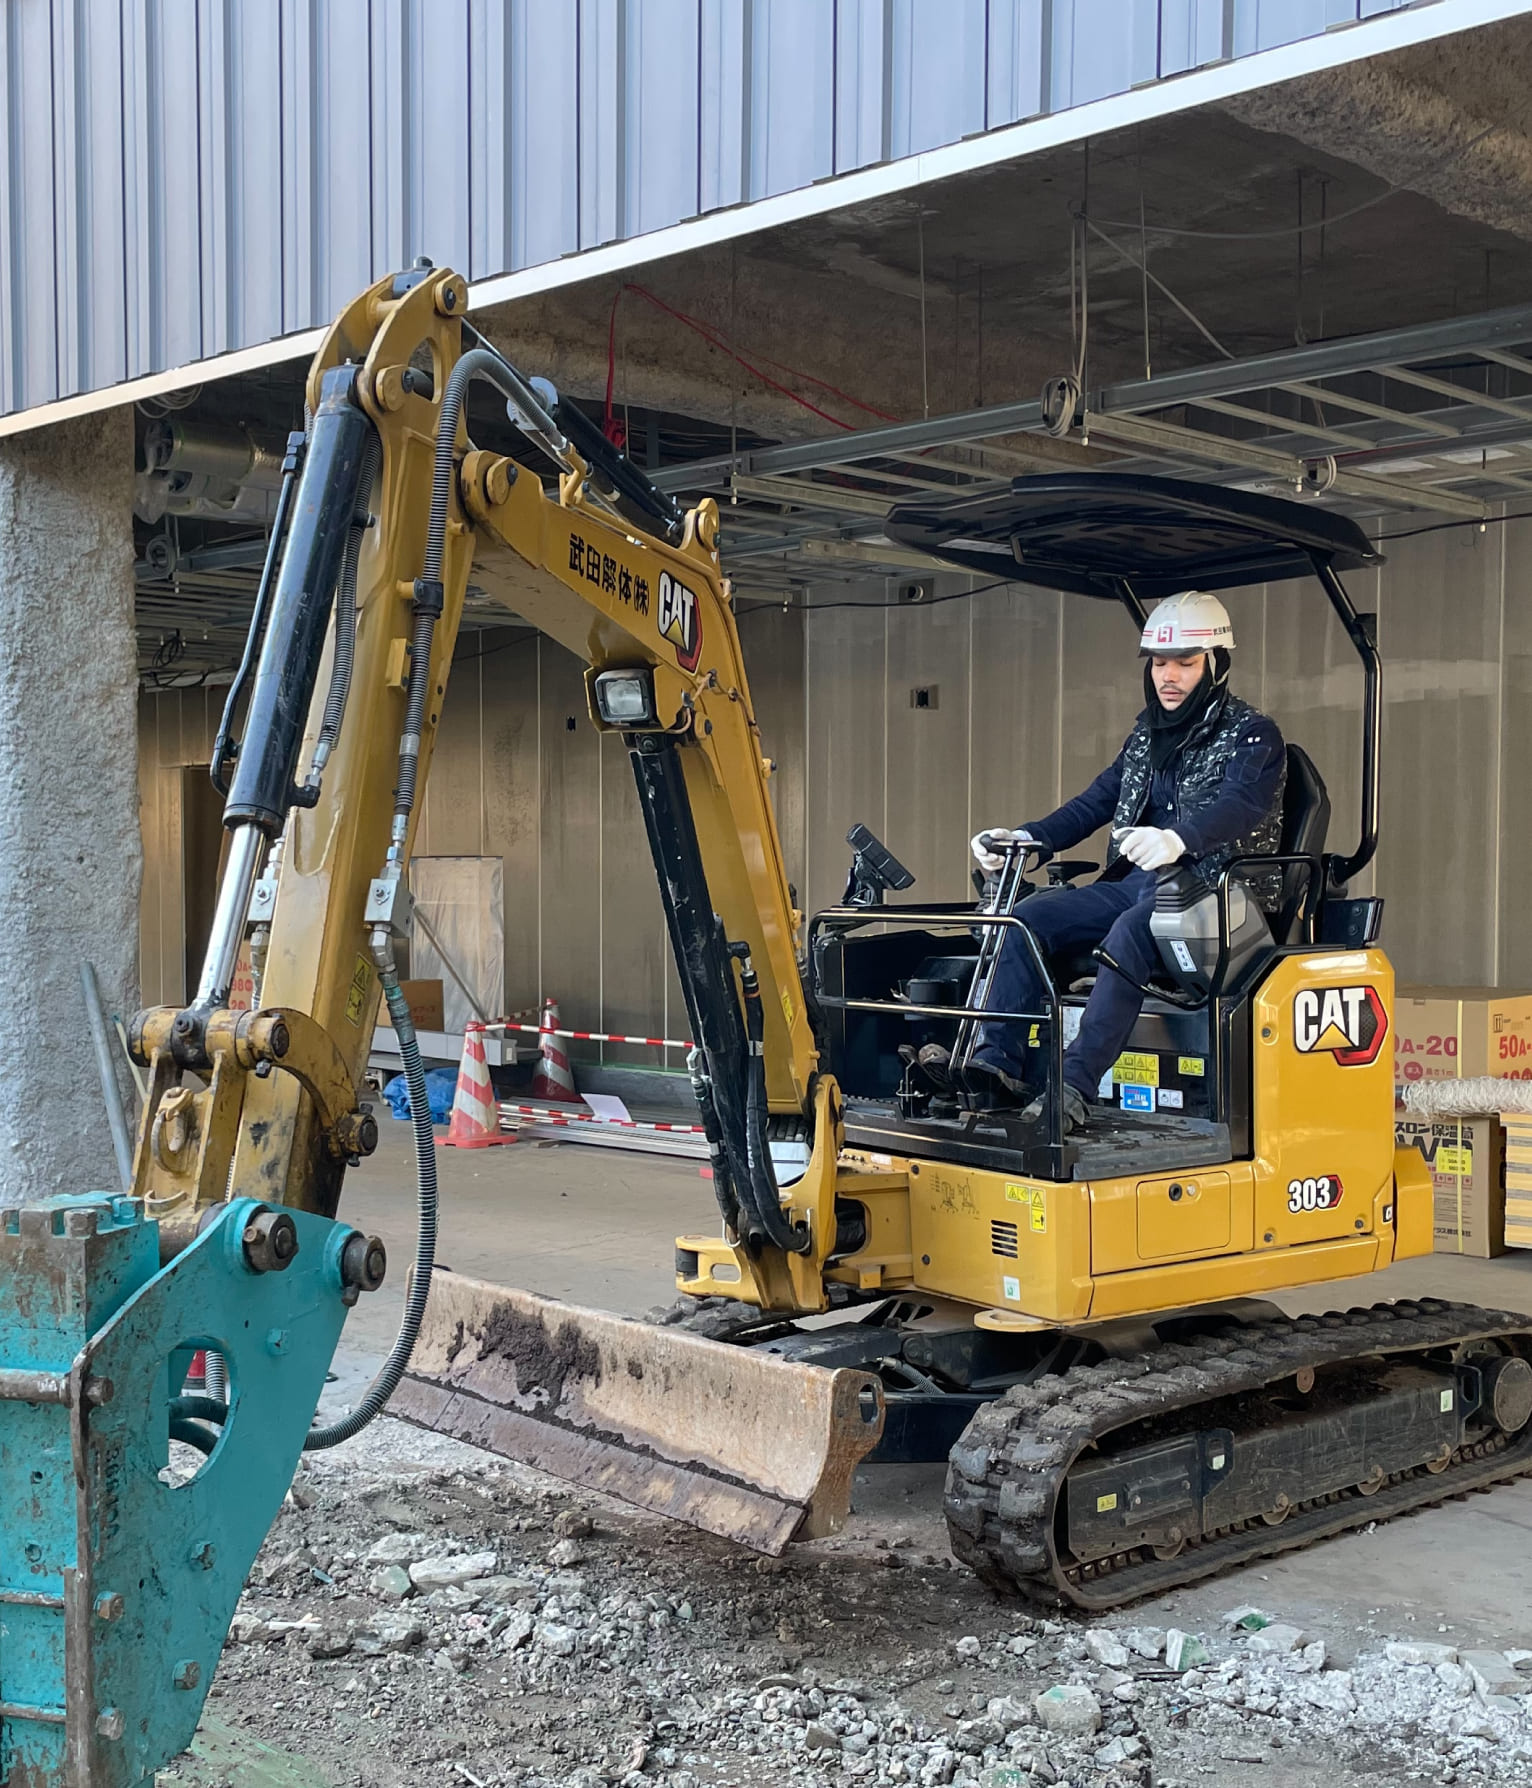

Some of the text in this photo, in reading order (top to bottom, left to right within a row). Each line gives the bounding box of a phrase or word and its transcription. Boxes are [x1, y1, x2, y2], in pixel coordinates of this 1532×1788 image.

[658, 571, 694, 651] CAT
[1294, 987, 1366, 1051] CAT
[1288, 1177, 1331, 1213] 303
